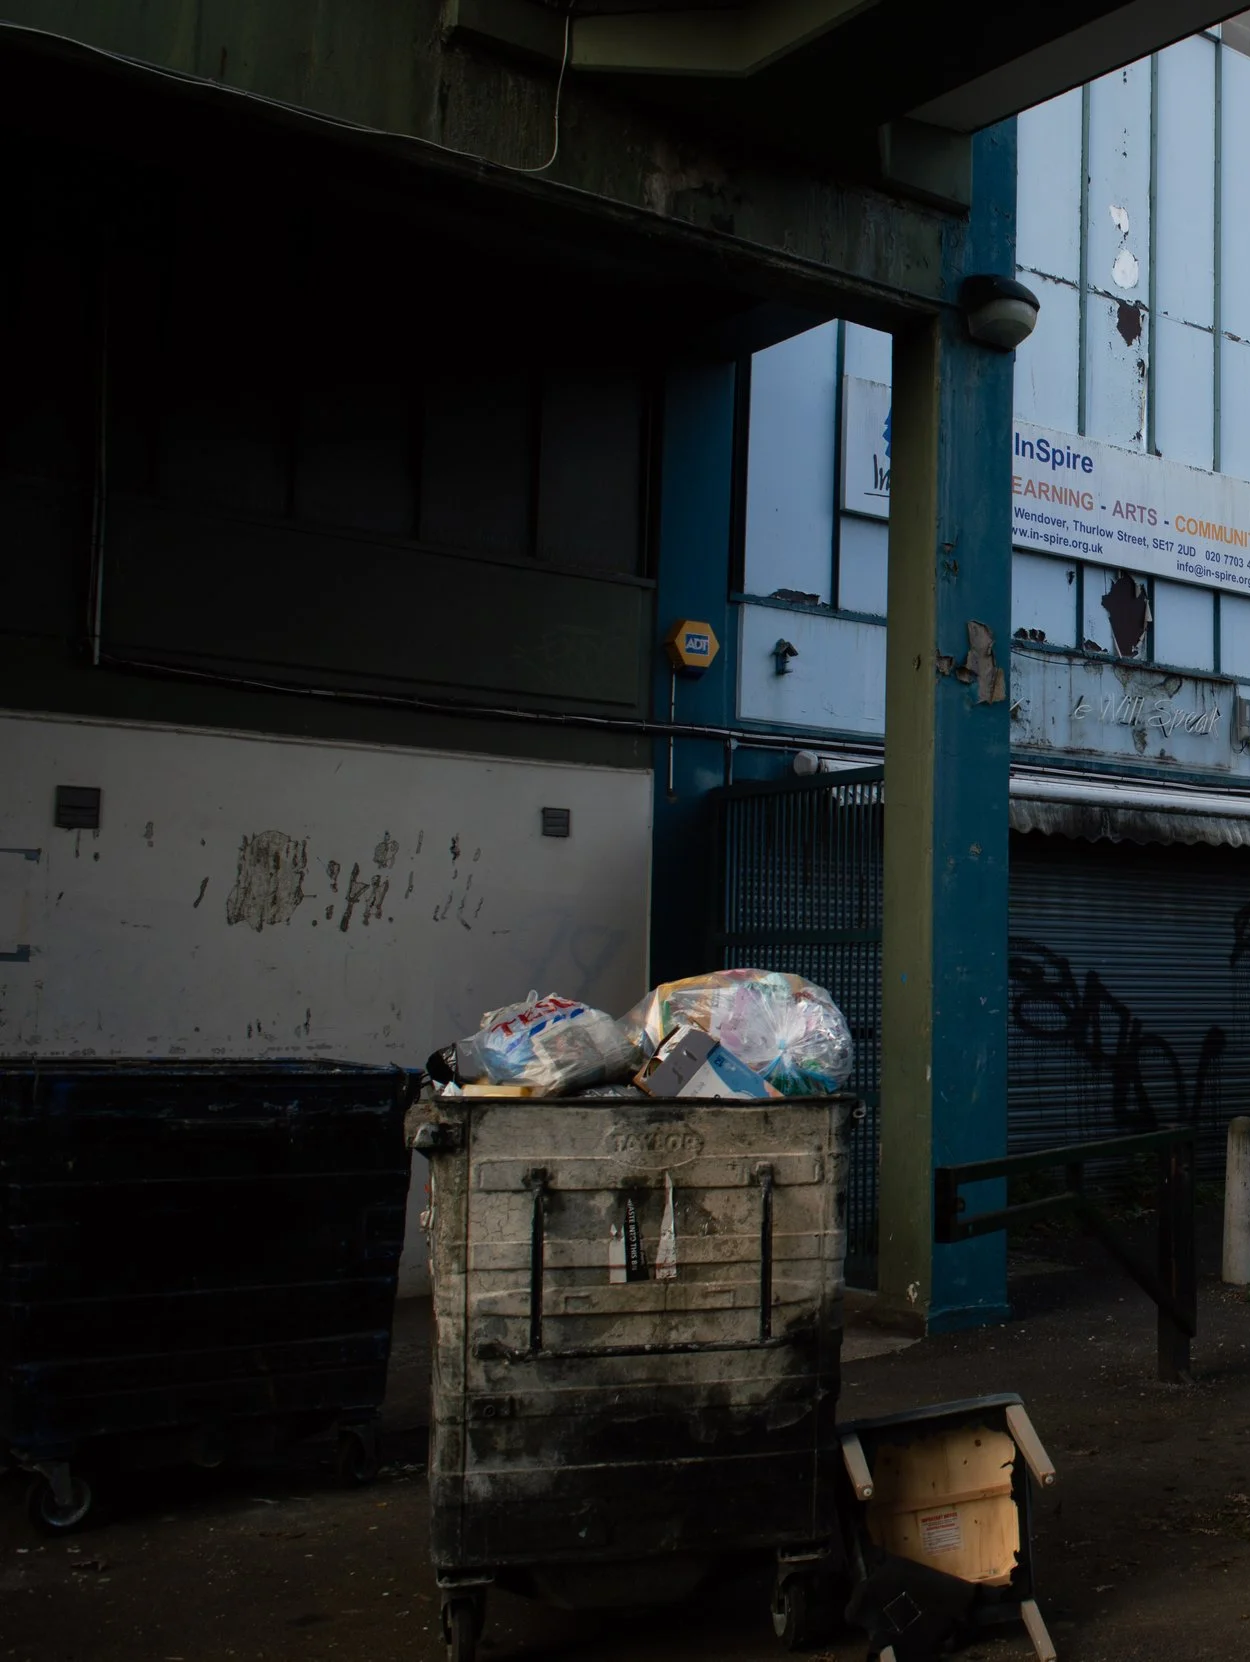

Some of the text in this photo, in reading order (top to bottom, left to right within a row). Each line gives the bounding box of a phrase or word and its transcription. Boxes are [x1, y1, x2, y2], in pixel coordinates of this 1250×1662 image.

[1015, 432, 1093, 473] InSpire
[1011, 475, 1094, 511] EARNING
[1112, 500, 1158, 526] ARTS
[1014, 506, 1069, 531] Wendover,
[1073, 520, 1114, 538] Thurlow
[1117, 530, 1149, 549] Street,
[1152, 538, 1174, 552] SE17
[1177, 544, 1196, 557] 2UD
[1205, 550, 1220, 563] 020
[1223, 554, 1244, 568] 7703
[686, 638, 708, 651] ADT
[613, 1132, 704, 1154] TAYLOR
